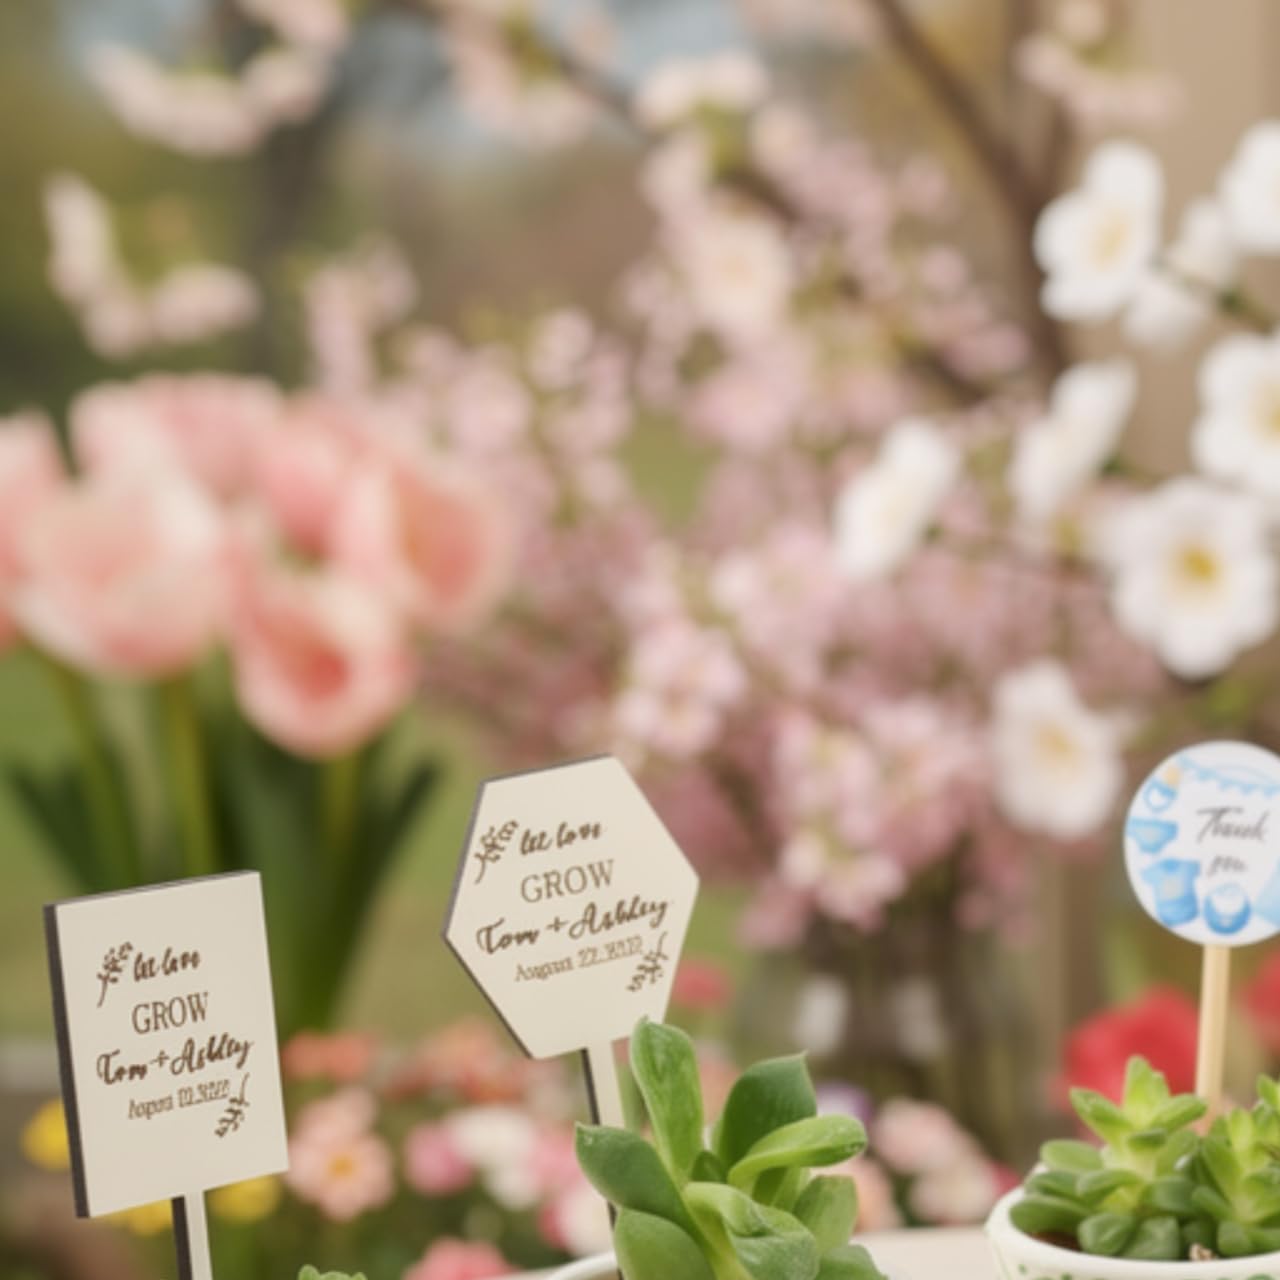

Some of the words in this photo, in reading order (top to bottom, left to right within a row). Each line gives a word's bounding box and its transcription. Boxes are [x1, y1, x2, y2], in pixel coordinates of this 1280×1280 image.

[520, 859, 615, 903] GROW
[476, 918, 540, 955] Tom
[568, 895, 668, 939] Ashley
[131, 992, 208, 1035] GROW
